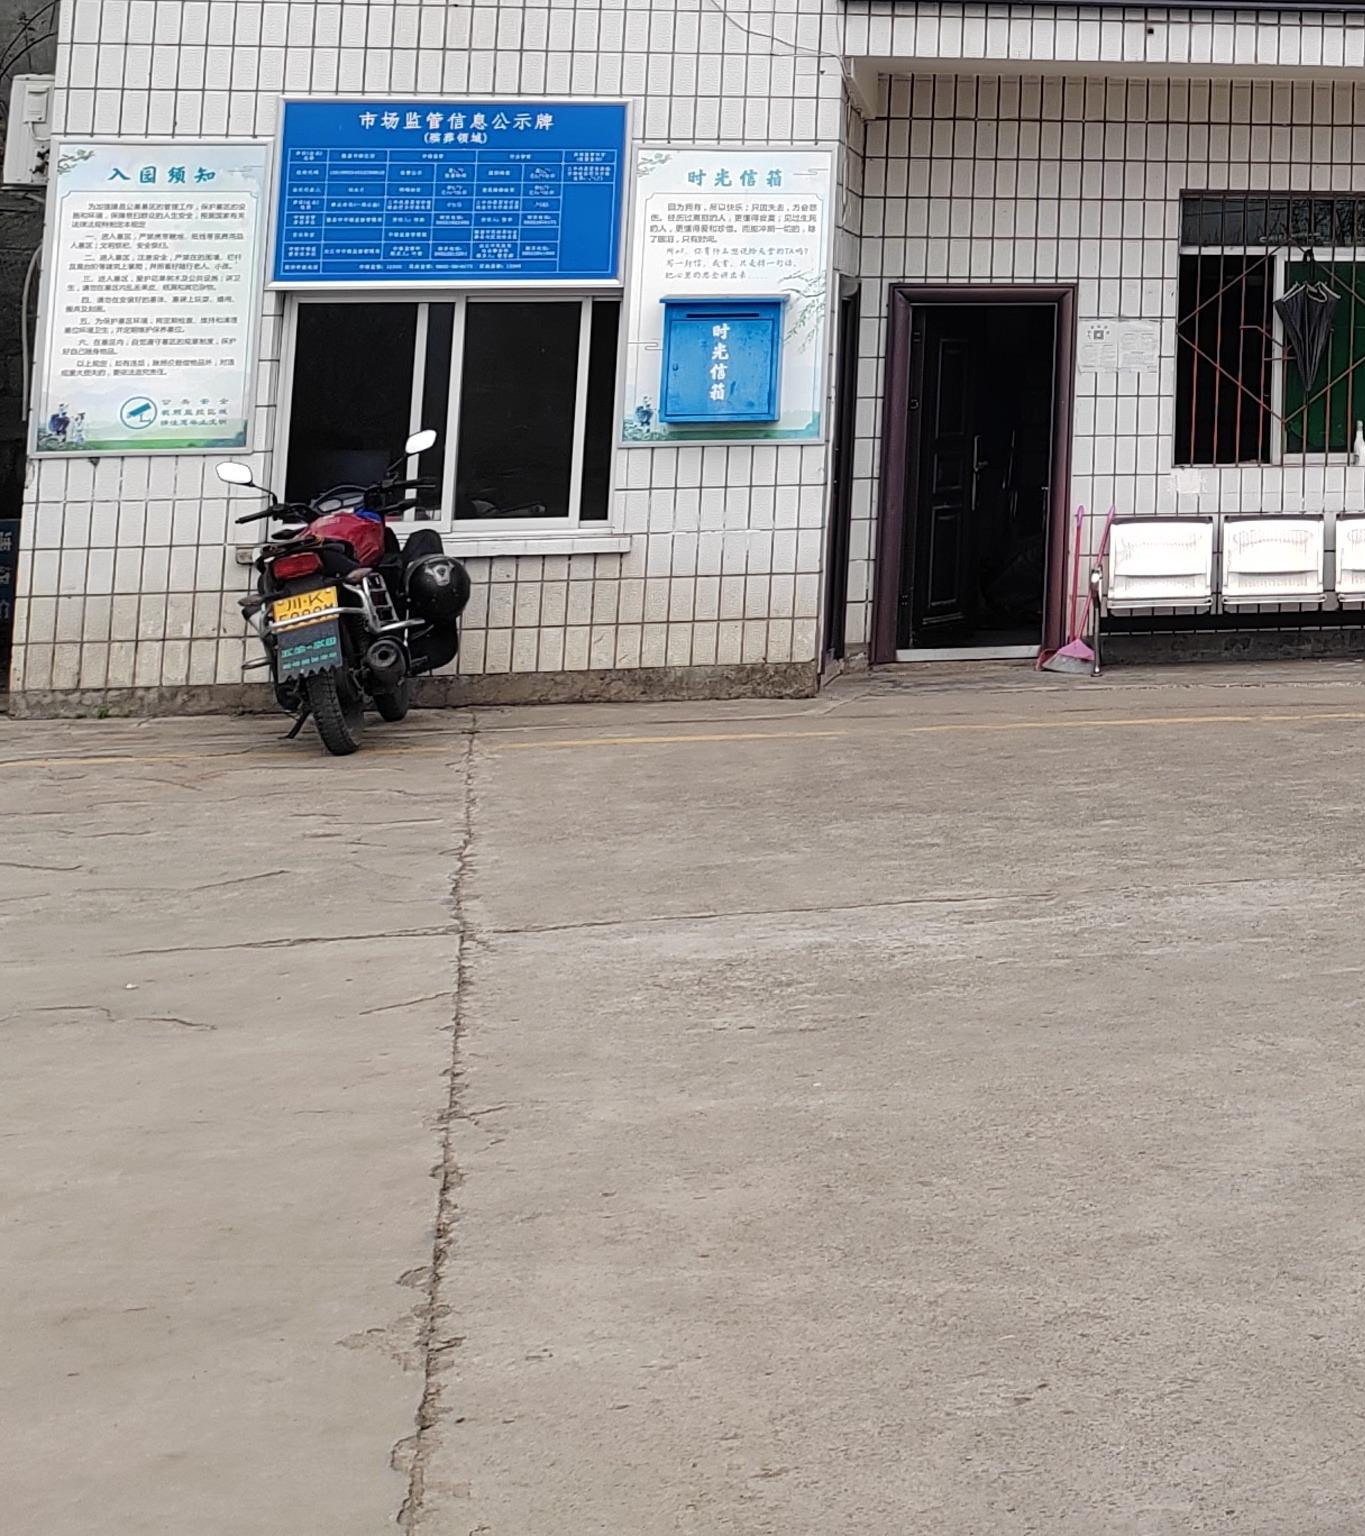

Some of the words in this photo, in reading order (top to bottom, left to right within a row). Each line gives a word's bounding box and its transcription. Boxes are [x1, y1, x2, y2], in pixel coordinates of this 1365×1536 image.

[359, 112, 554, 130] 市场监管信息公示牌
[108, 166, 216, 184] 入园须知
[687, 168, 783, 187] 时光信箱
[710, 323, 730, 401] 时光信箱
